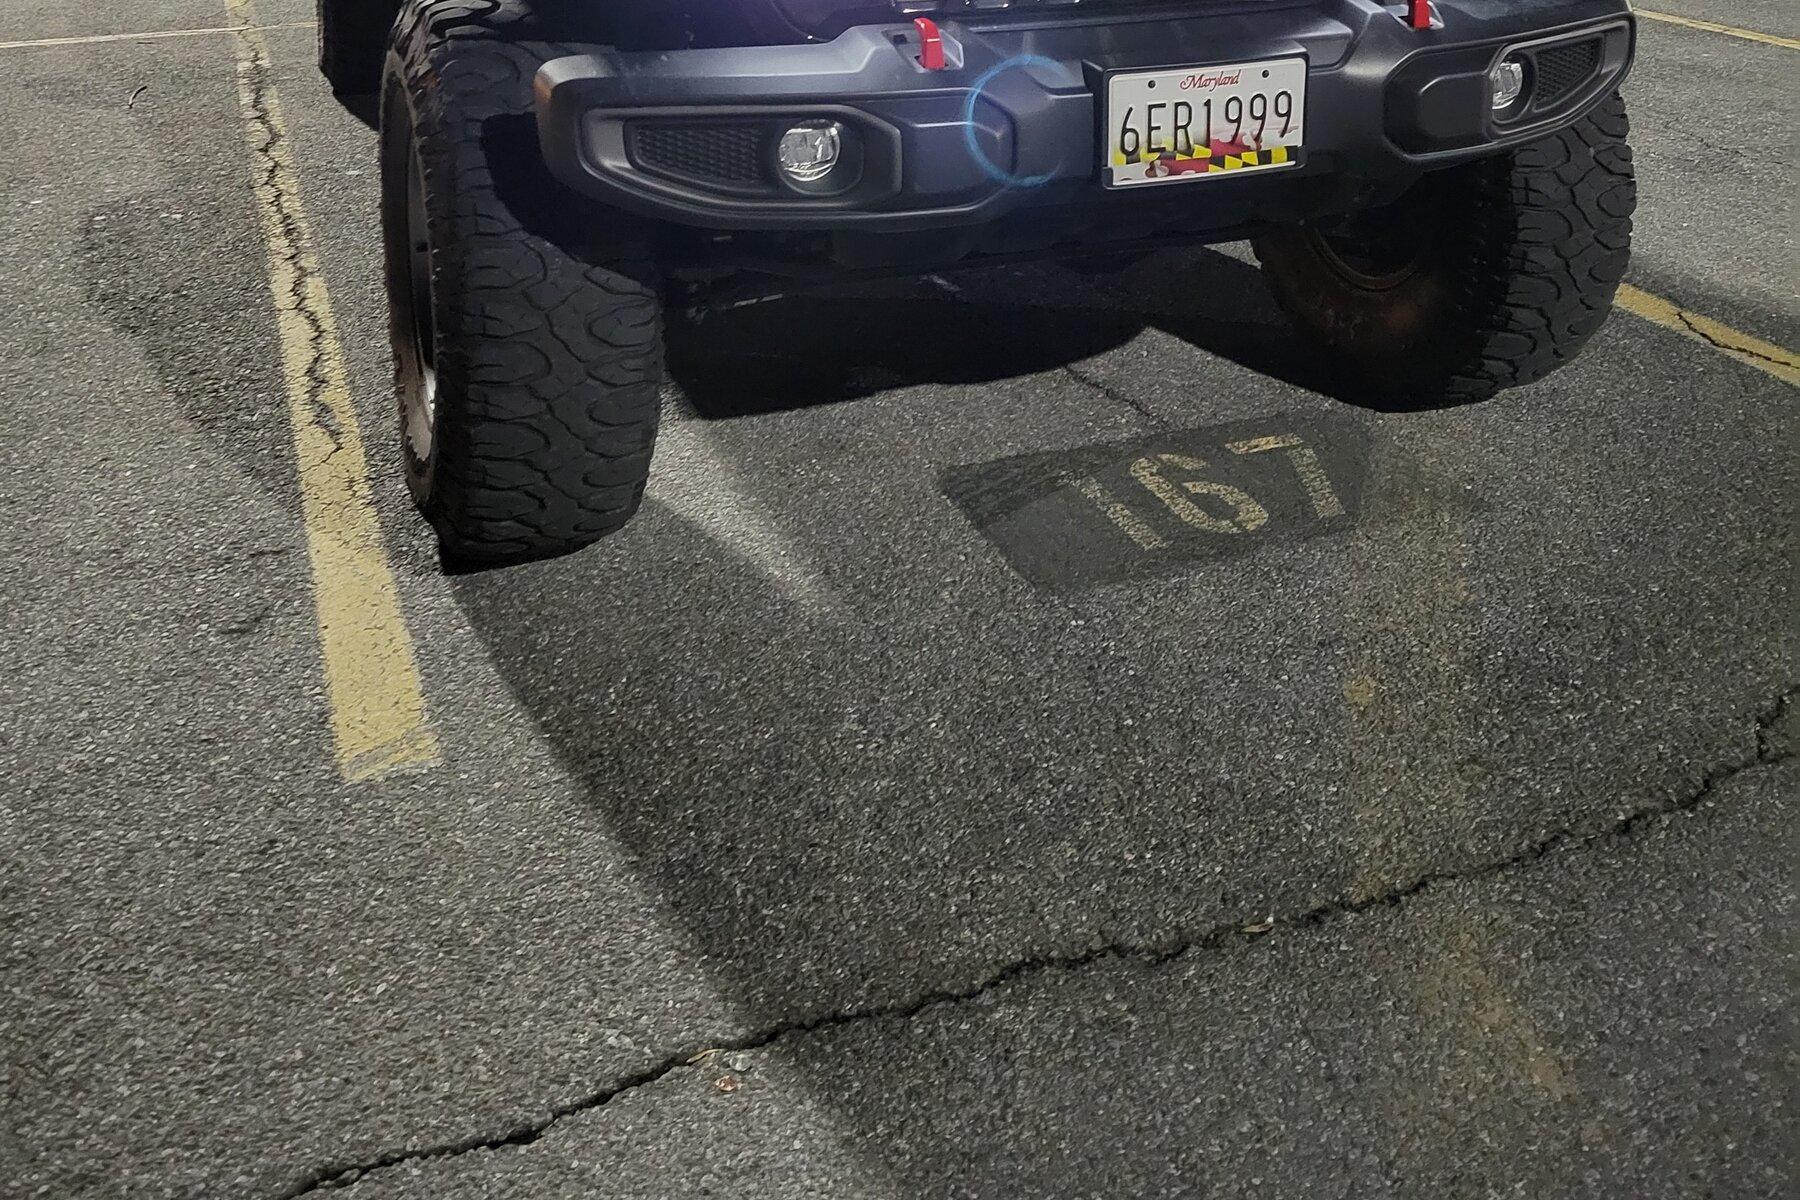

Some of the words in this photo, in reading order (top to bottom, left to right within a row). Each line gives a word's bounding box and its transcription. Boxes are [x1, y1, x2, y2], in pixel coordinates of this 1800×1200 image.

[1179, 69, 1241, 91] Maryland
[1120, 90, 1292, 157] 6ER1999
[1055, 433, 1346, 551] 167
